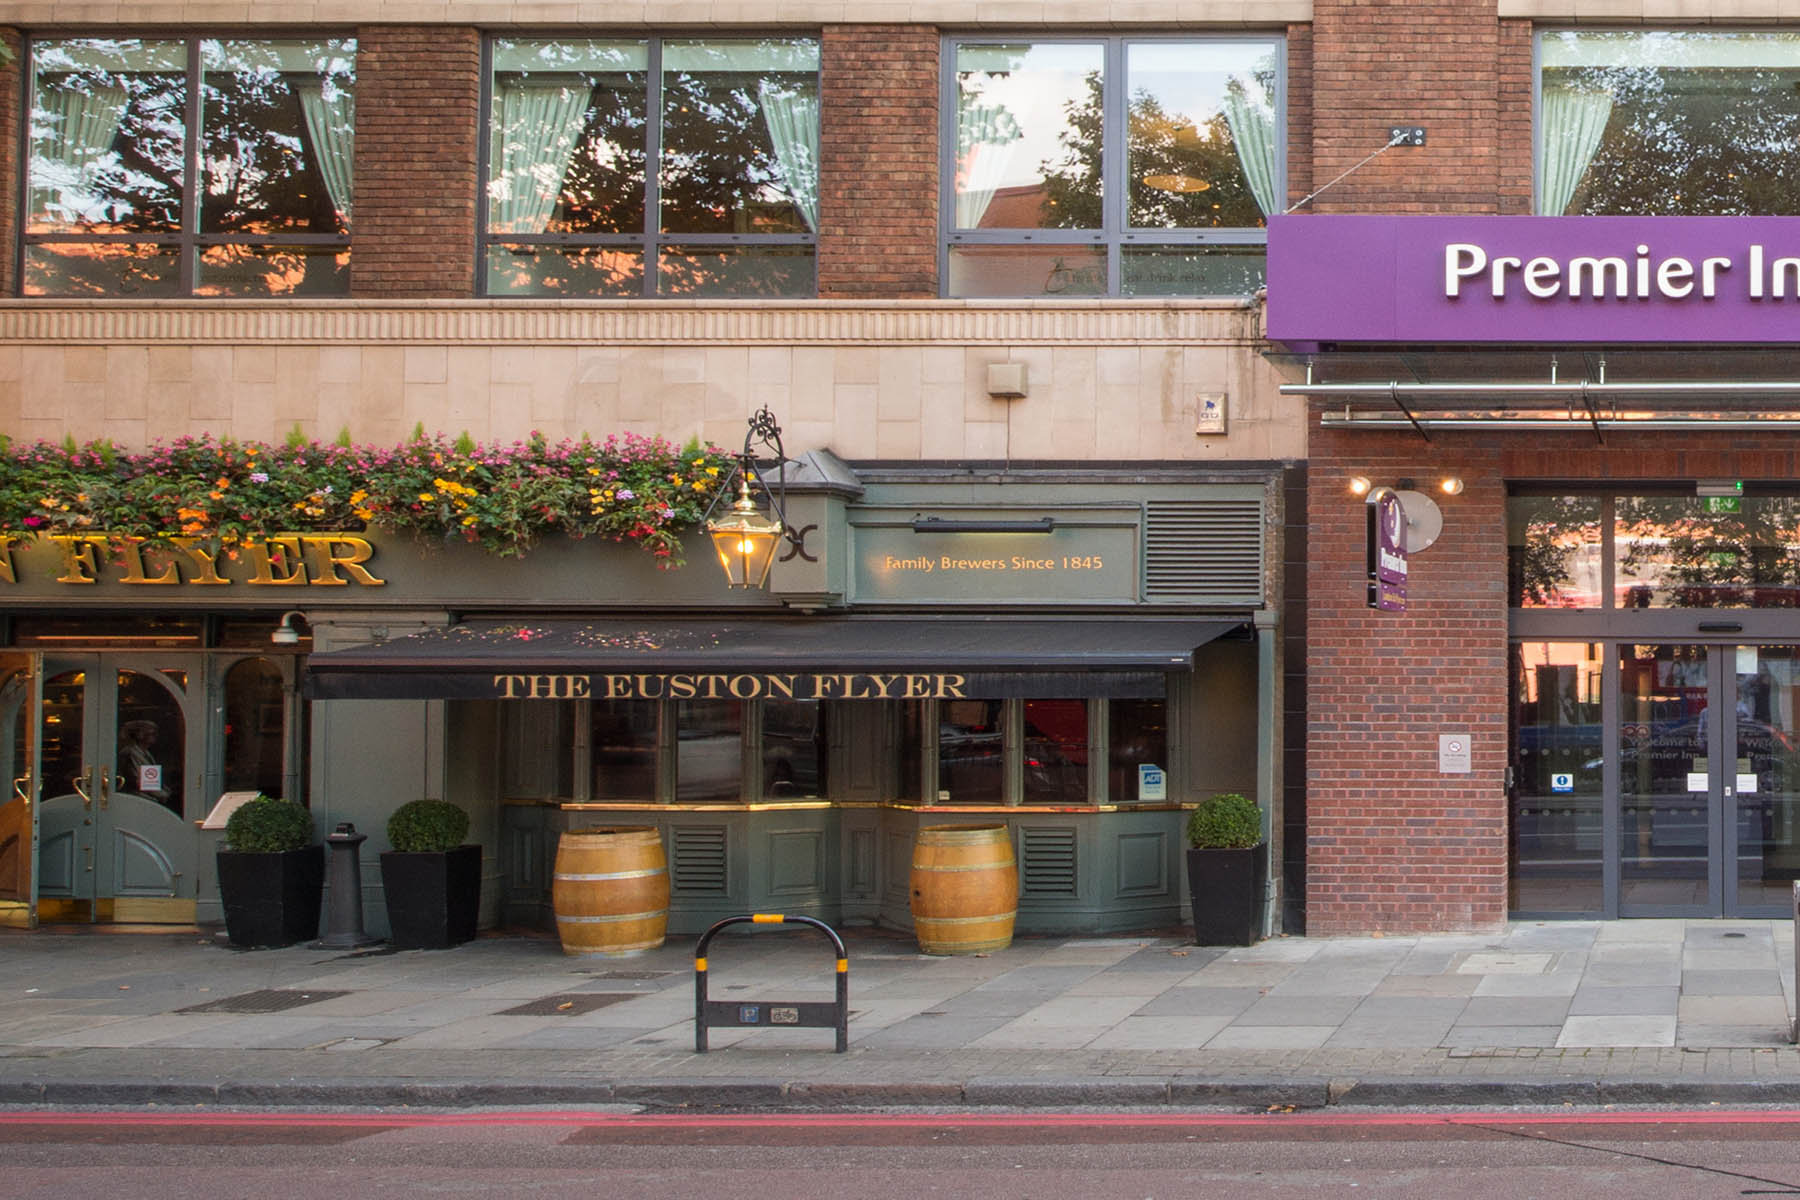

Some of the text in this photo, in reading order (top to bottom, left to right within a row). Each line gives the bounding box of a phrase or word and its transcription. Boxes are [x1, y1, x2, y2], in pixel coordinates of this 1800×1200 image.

[1444, 243, 1733, 298] Premier
[48, 534, 385, 585] FLYER
[885, 556, 1103, 572] Family Brewers Since 1845
[494, 674, 968, 699] THE EUSTON FLYER
